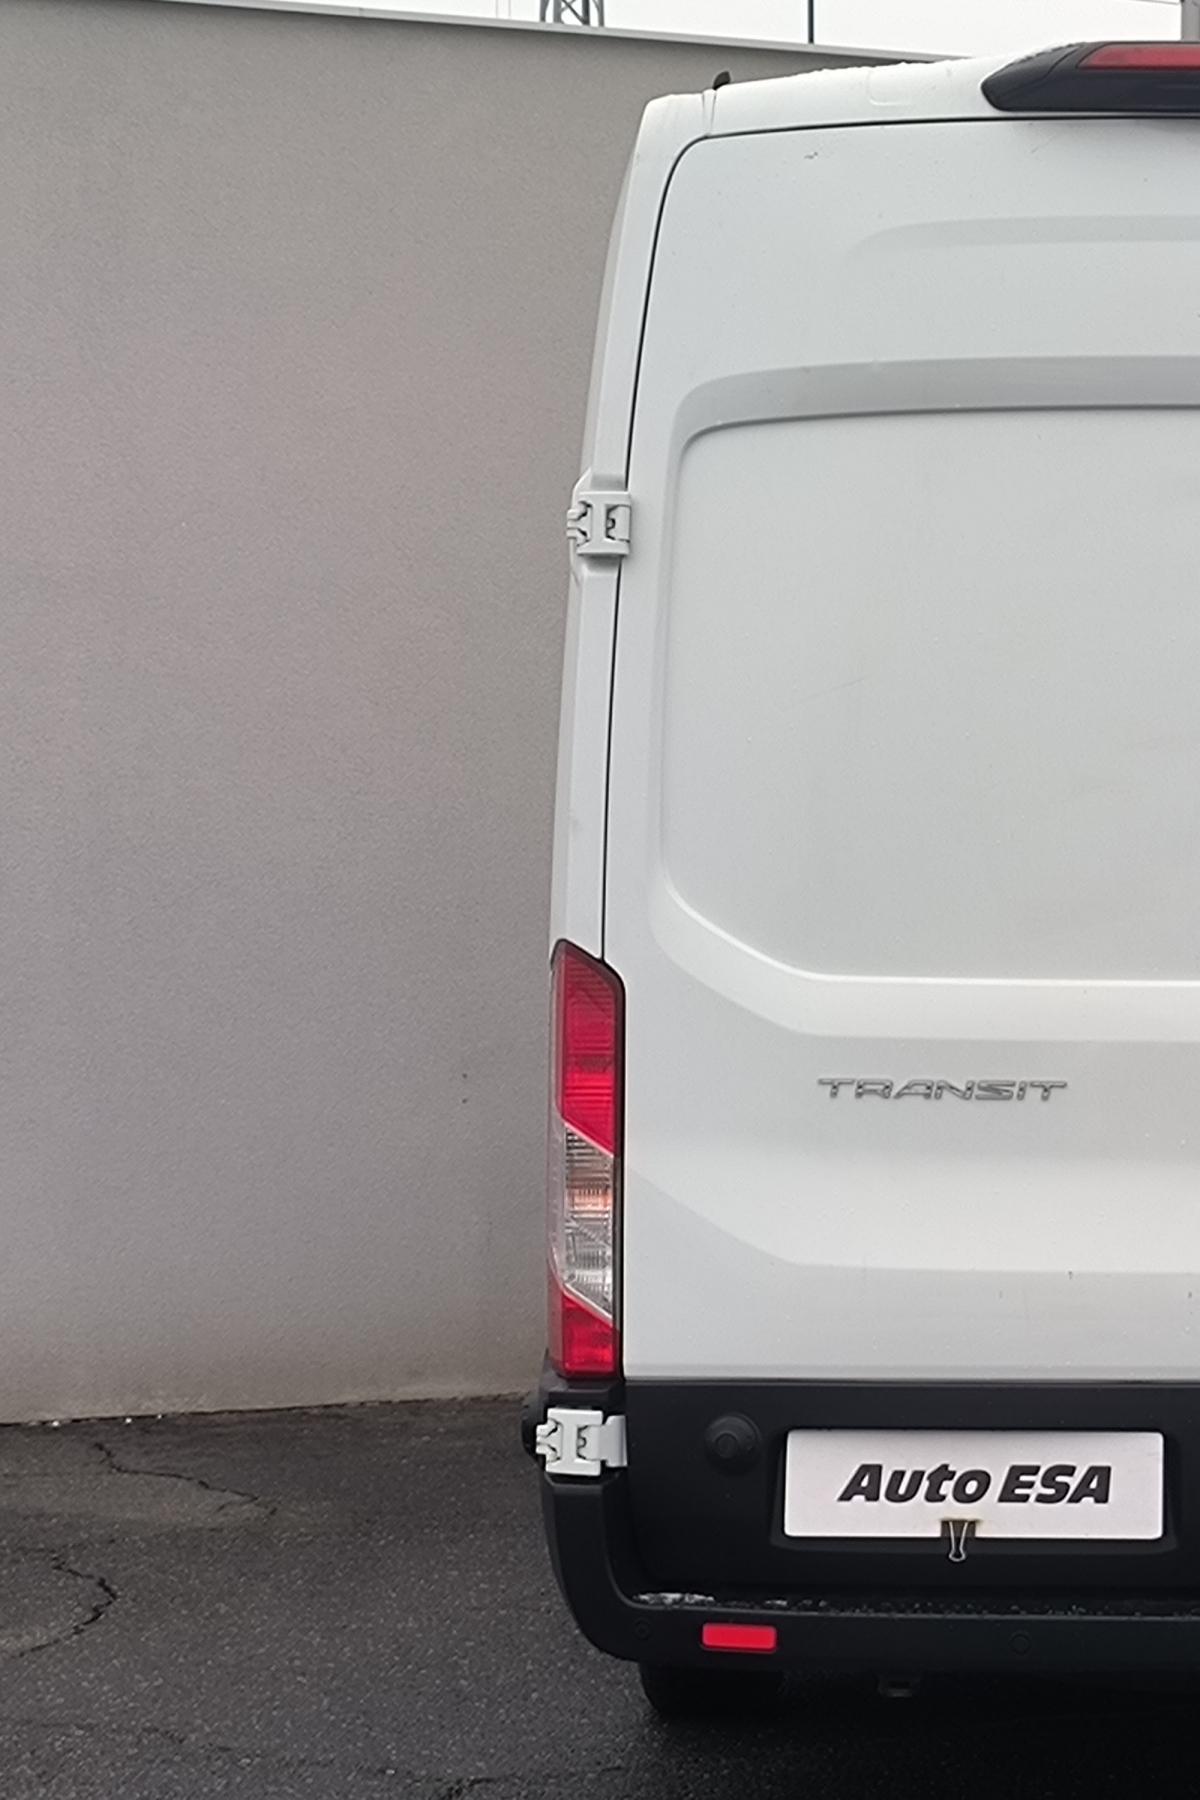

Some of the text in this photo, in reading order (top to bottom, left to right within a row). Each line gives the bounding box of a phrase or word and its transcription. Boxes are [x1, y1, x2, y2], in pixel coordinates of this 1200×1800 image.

[818, 1078, 1068, 1101] TRANSIT
[837, 1463, 1112, 1504] Auto ESA
